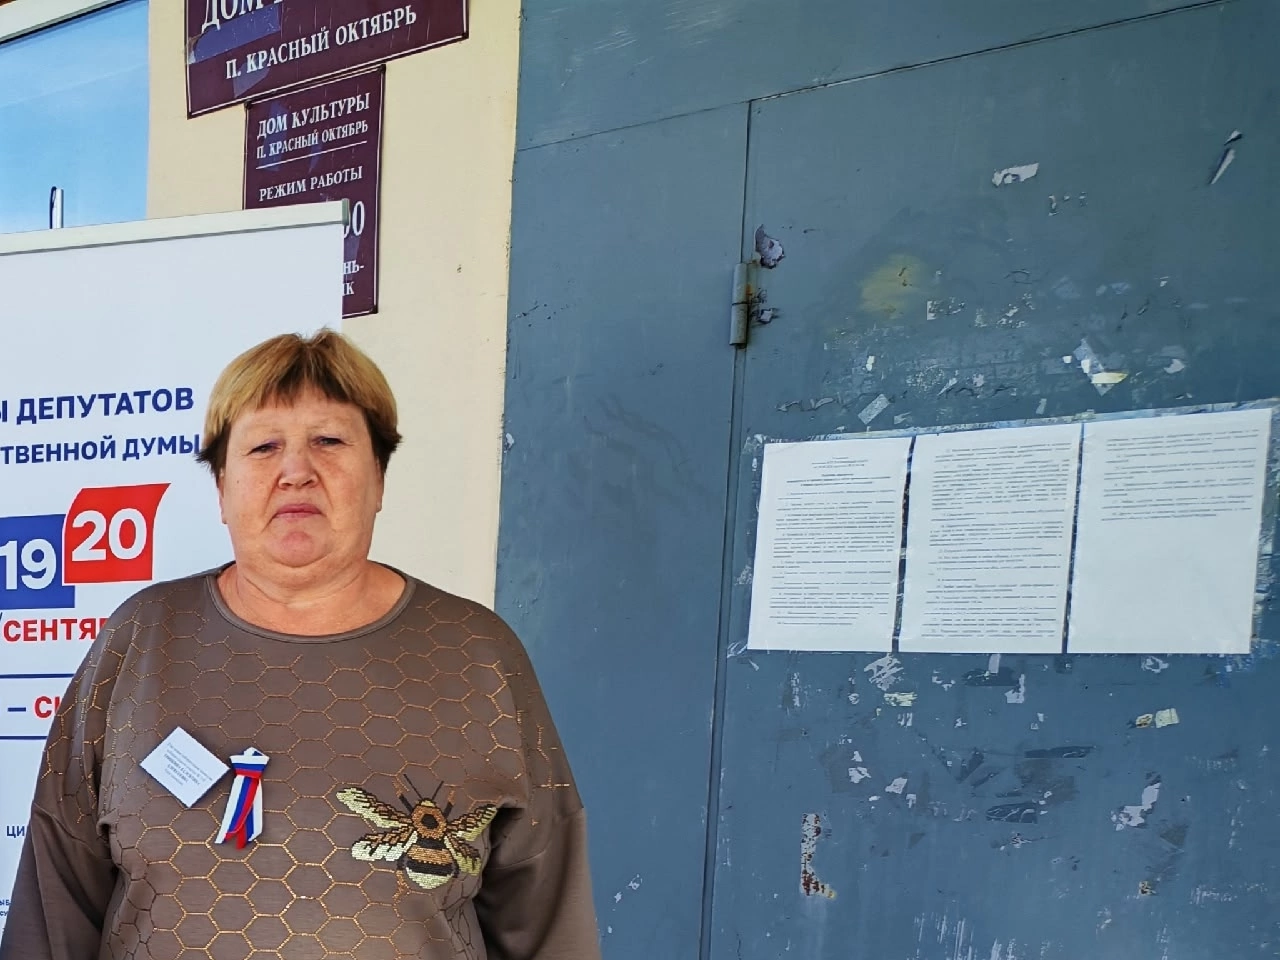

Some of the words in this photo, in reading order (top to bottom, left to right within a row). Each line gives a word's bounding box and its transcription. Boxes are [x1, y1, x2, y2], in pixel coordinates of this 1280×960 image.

[225, 59, 241, 80] П.
[246, 27, 329, 73] КРАСНЫЙ
[335, 6, 417, 46] ОКТЯБРЬ
[257, 114, 287, 140] ДОМ
[291, 93, 370, 128] КУЛЬТУРЫ
[256, 145, 266, 159] П.
[268, 130, 319, 158] КРАСНЫЙ
[321, 120, 368, 143] ОКТЯБРЬ
[259, 179, 307, 201] РЕЖИМ
[310, 166, 362, 190] РАБОТЫ
[16, 387, 195, 425] ДЕПУТАТОВ
[122, 434, 200, 461] ДУМЫ
[71, 508, 148, 562] 20
[3, 617, 108, 643] СЕНТЯ
